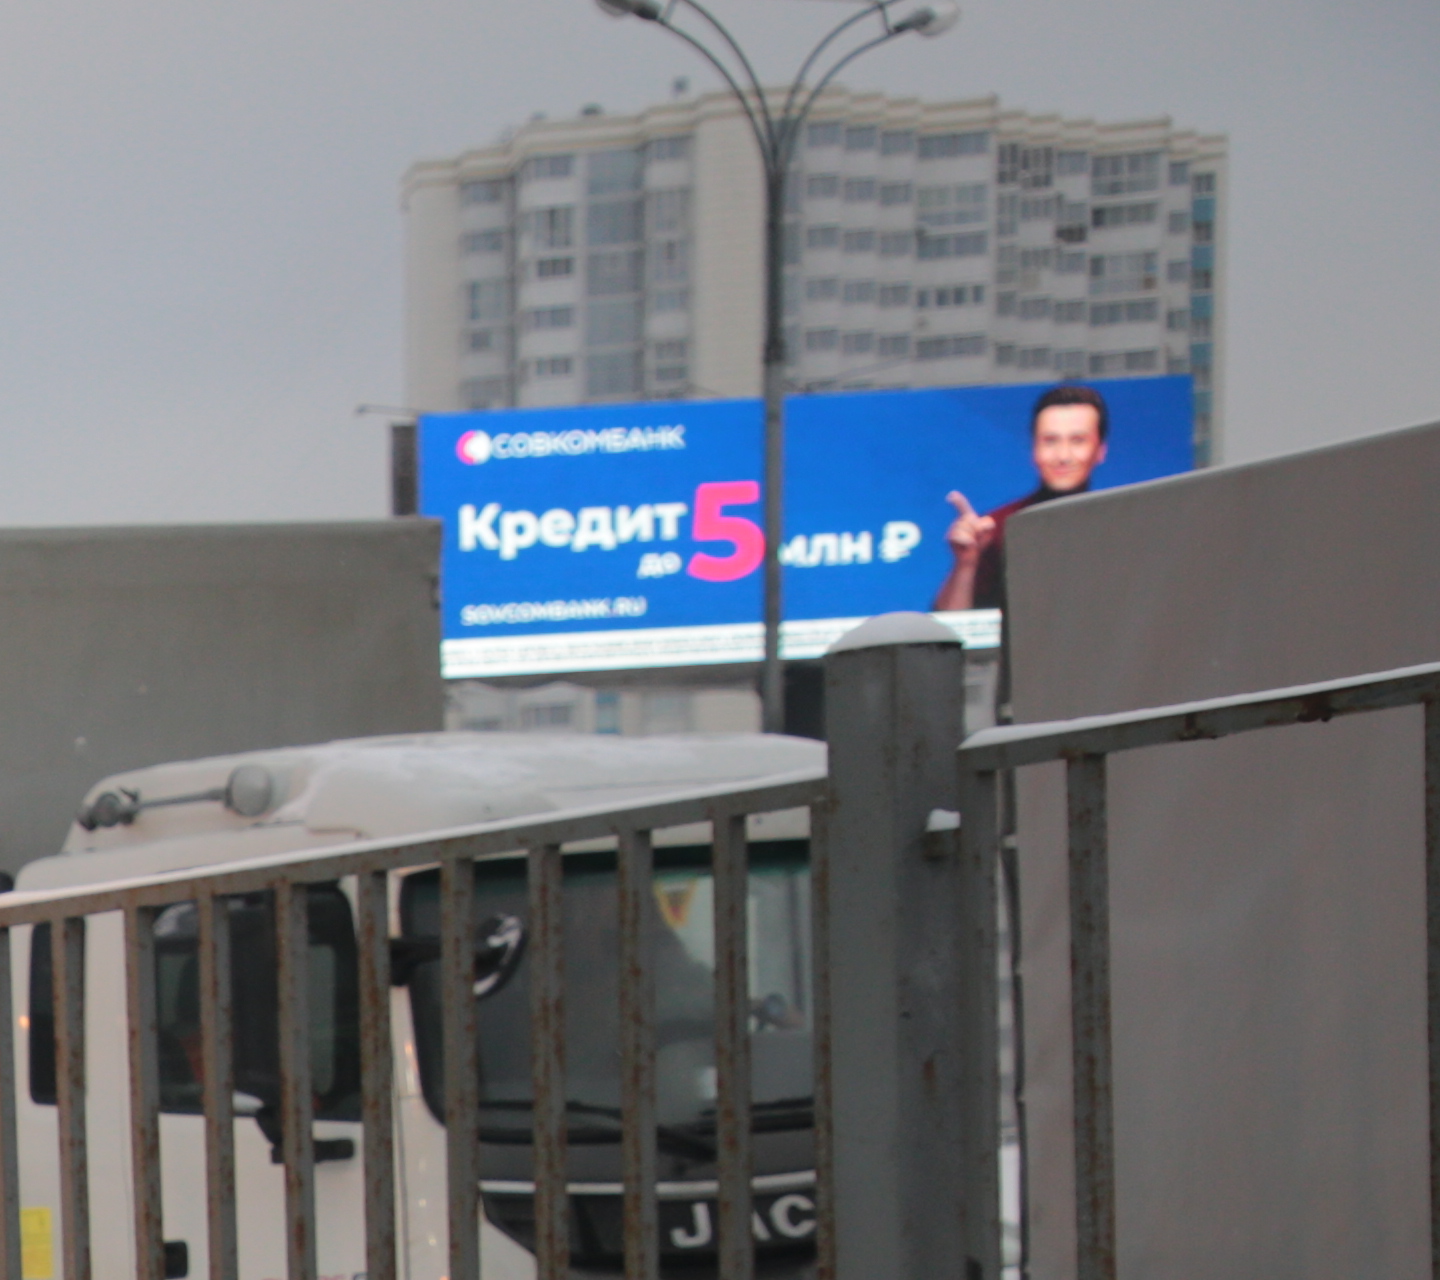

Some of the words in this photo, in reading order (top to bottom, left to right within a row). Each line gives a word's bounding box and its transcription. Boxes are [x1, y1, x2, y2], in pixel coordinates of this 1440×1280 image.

[492, 425, 686, 459] СОВКОМБАНК
[458, 501, 687, 560] Кредит
[687, 480, 766, 582] 5
[637, 550, 683, 579] до
[460, 596, 647, 627] SOVCOMBANK.RU
